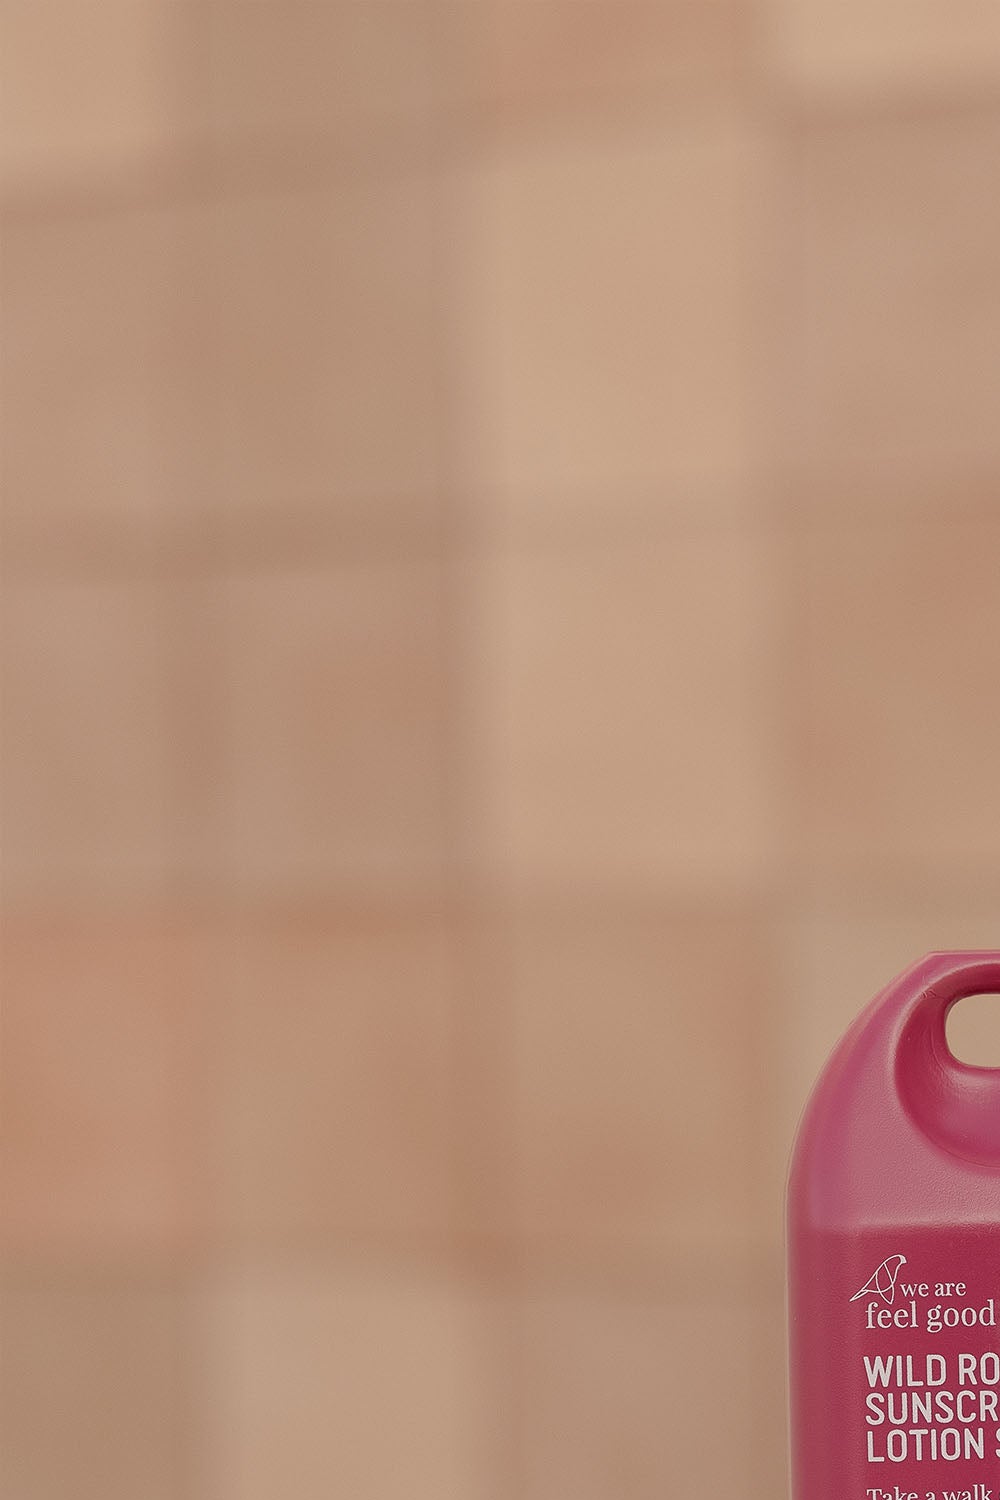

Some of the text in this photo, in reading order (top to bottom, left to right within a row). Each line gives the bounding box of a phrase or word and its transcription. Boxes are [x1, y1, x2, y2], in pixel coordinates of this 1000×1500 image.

[899, 1282, 967, 1298] we are
[864, 1300, 919, 1329] feel
[926, 1298, 997, 1334] good
[862, 1353, 947, 1388] WILD
[867, 1427, 985, 1463] LOTION
